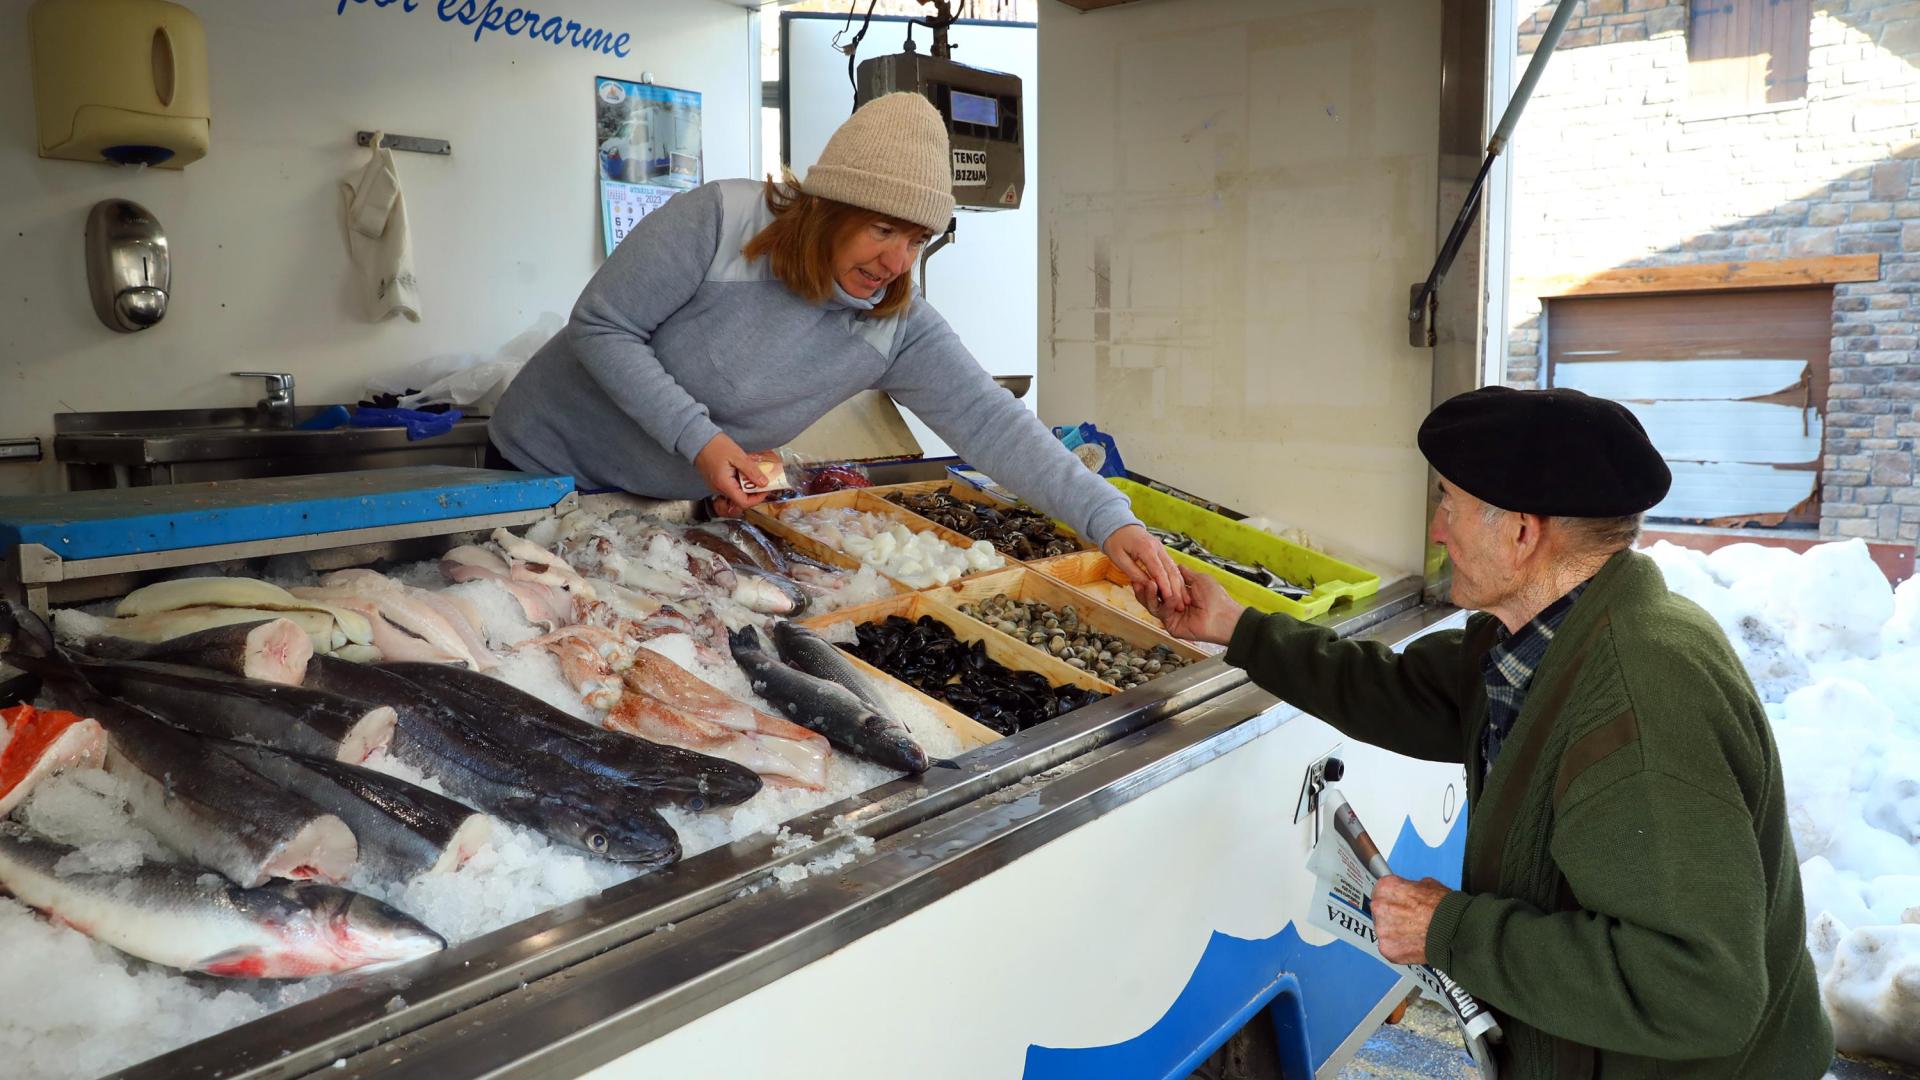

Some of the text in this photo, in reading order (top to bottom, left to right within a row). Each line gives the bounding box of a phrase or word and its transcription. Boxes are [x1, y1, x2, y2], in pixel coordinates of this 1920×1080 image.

[436, 0, 631, 58] esperarme
[954, 152, 986, 164] TENGO
[955, 170, 986, 181] BIZUM
[645, 194, 662, 204] 2023
[615, 217, 634, 227] 6 7
[615, 229, 624, 239] 13
